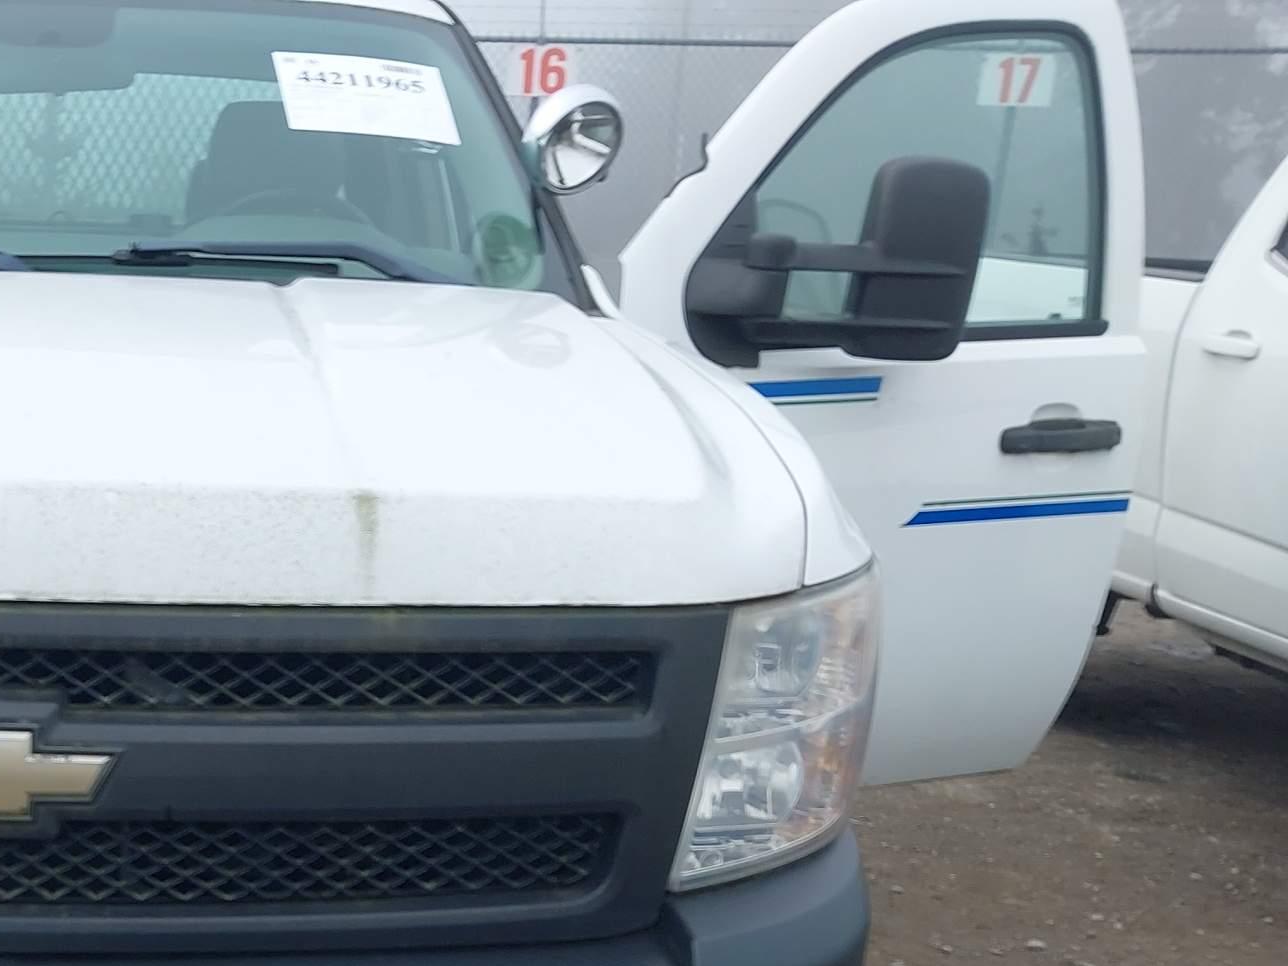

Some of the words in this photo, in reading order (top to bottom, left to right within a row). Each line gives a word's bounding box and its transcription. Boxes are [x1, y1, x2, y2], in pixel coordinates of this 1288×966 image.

[297, 70, 426, 94] 44211965
[521, 47, 566, 94] 16
[999, 57, 1041, 103] 17
